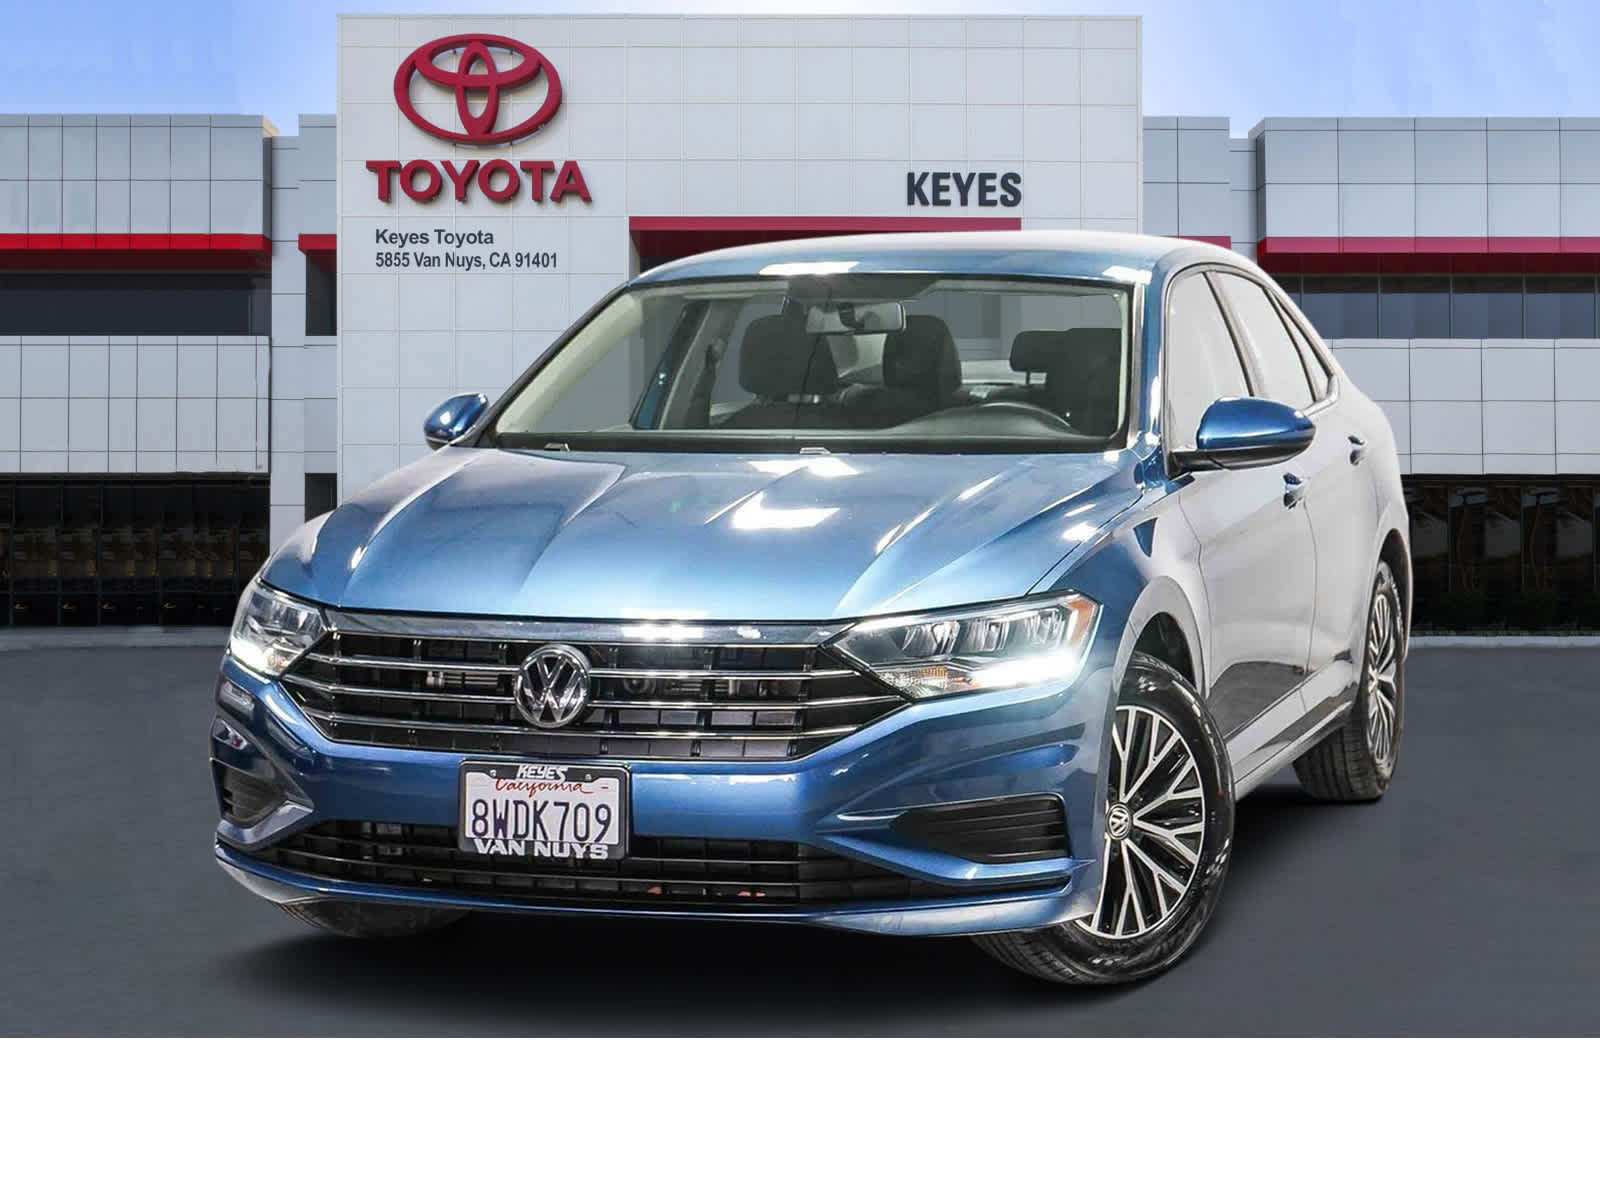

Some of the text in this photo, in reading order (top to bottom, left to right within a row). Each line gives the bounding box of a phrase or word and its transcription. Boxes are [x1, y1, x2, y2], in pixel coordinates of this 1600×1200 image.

[365, 159, 592, 202] TOYOTA
[907, 171, 1022, 207] KEYES
[375, 228, 495, 248] Keyes Toyota
[375, 252, 558, 271] 5855 Van Nuys, CA 91401
[515, 763, 568, 781] KEYES
[472, 799, 612, 843] 8WDK709
[474, 838, 609, 860] VAN NUYS
